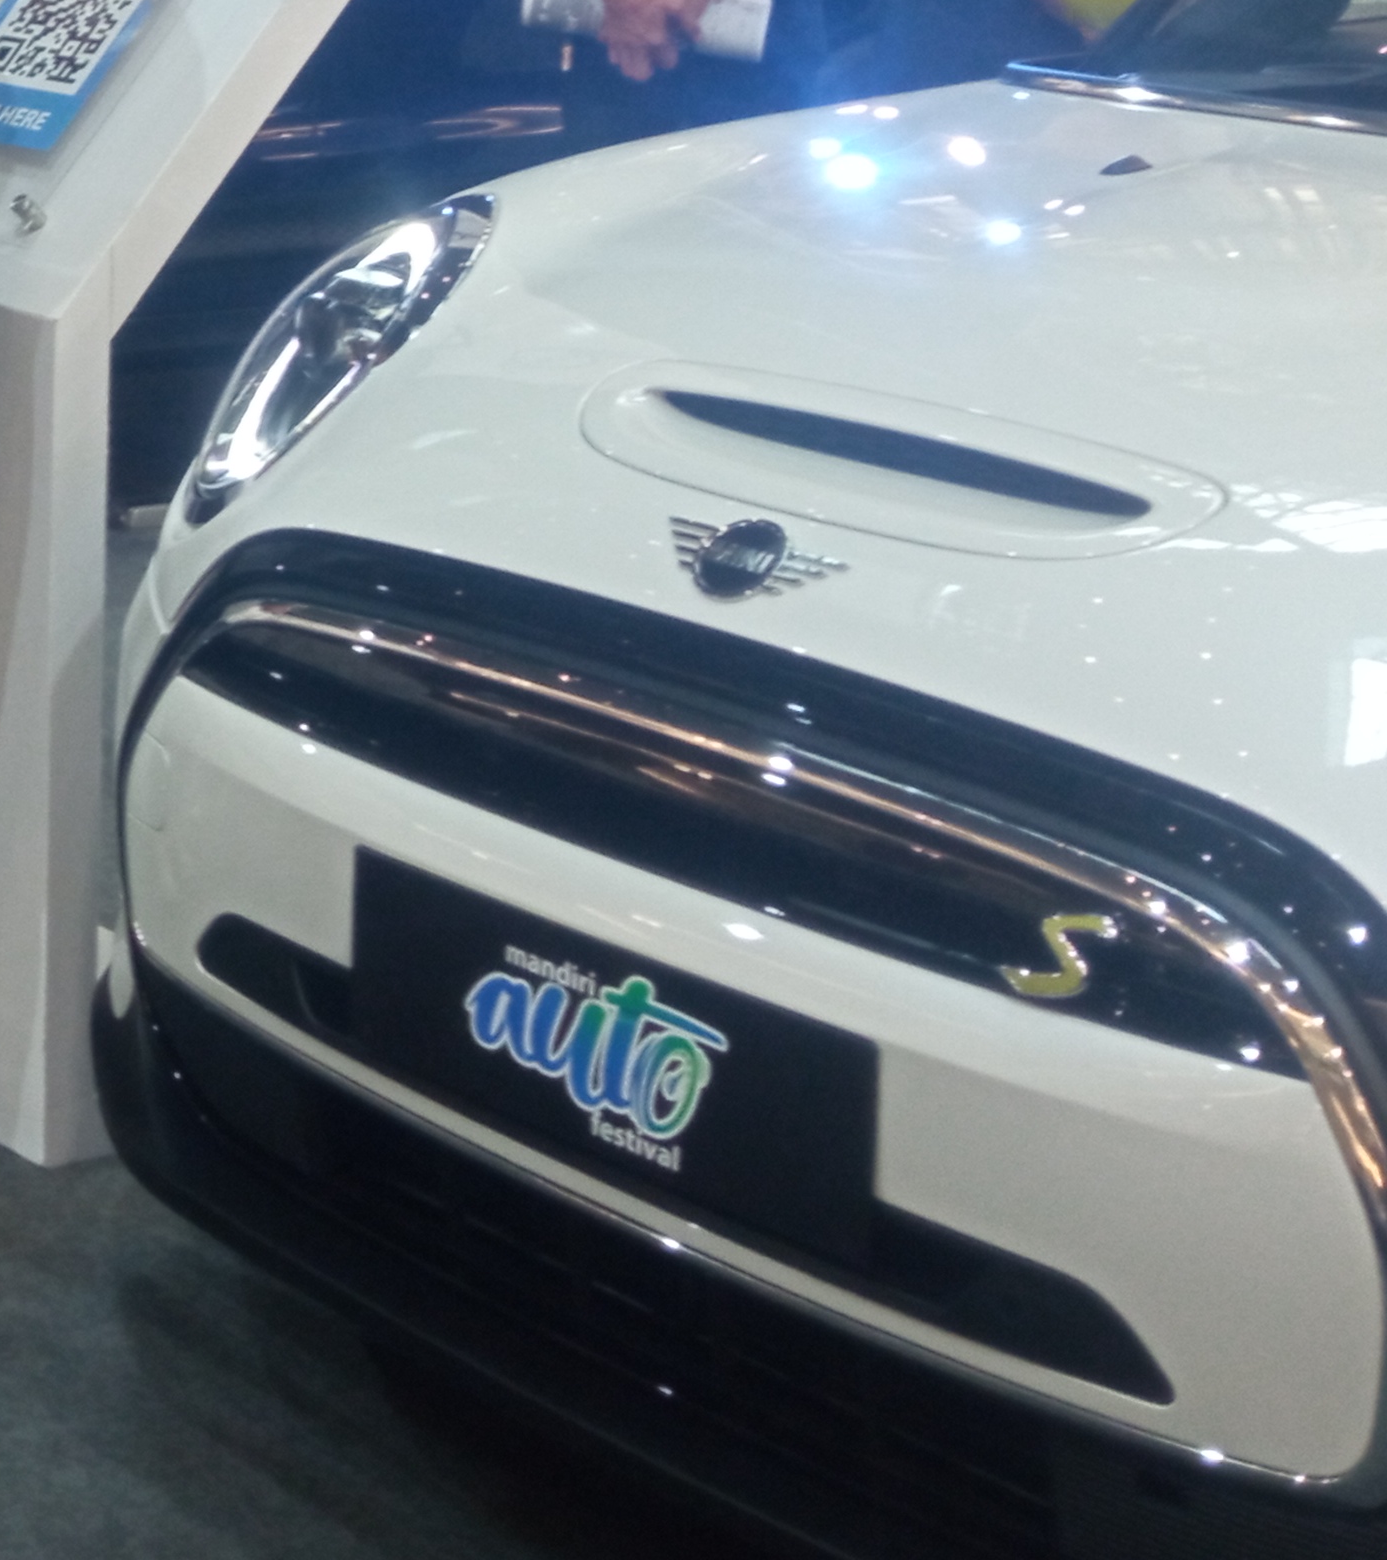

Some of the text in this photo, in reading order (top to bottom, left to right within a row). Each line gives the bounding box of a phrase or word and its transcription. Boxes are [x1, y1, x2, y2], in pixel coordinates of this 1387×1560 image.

[504, 944, 597, 997] mandiri
[464, 970, 730, 1140] auto
[589, 1108, 682, 1172] festival
